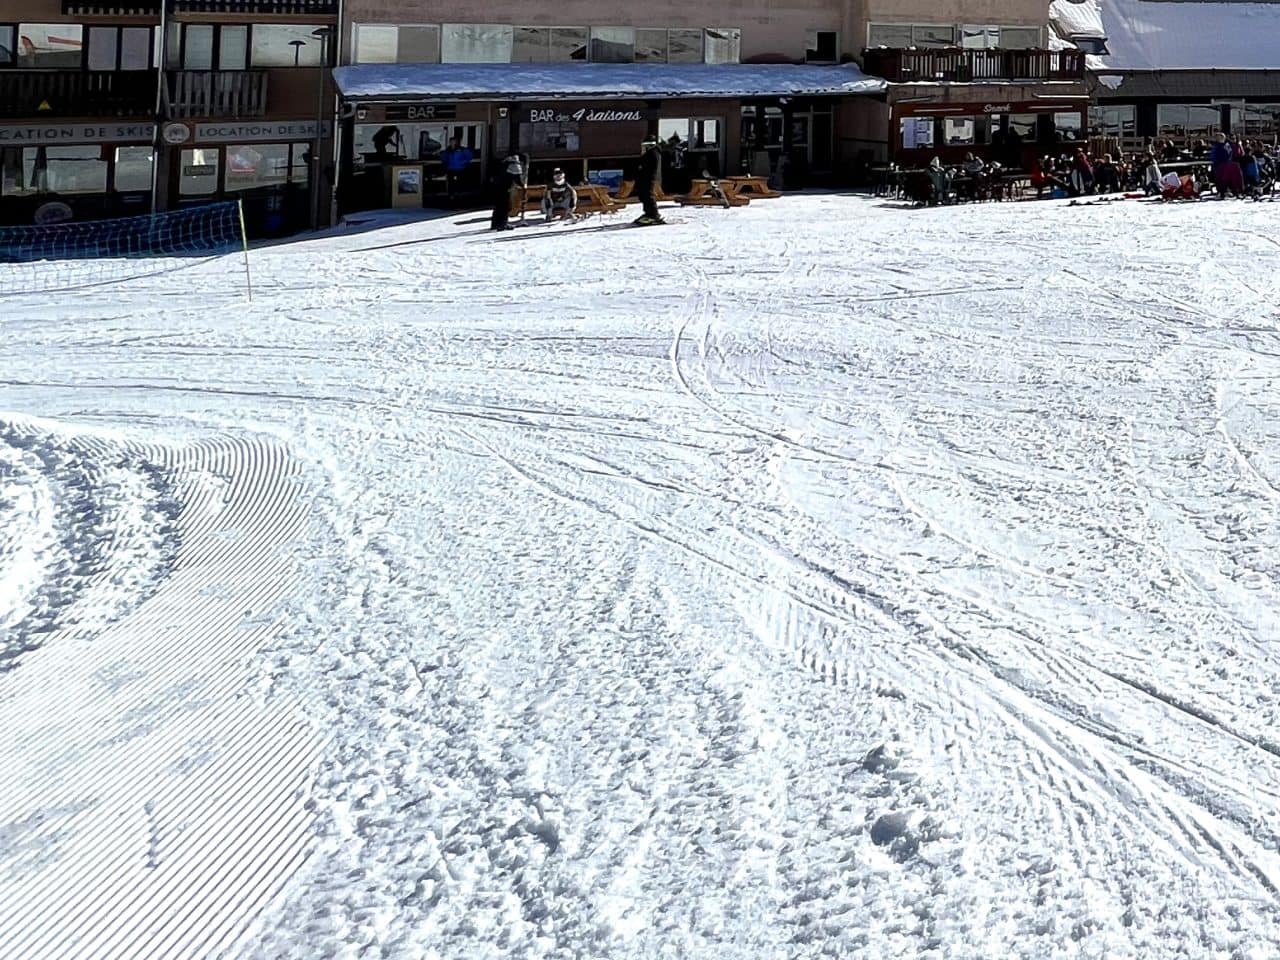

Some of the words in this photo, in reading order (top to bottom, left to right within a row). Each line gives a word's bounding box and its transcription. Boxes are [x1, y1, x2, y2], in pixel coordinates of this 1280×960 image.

[407, 106, 435, 119] BAR
[530, 109, 554, 122] BAR
[556, 112, 569, 122] des
[572, 108, 586, 121] 4
[586, 110, 642, 122] saisons
[84, 127, 106, 138] DE
[117, 125, 154, 137] SKIS
[200, 125, 272, 137] LOCATION
[278, 124, 296, 135] DE
